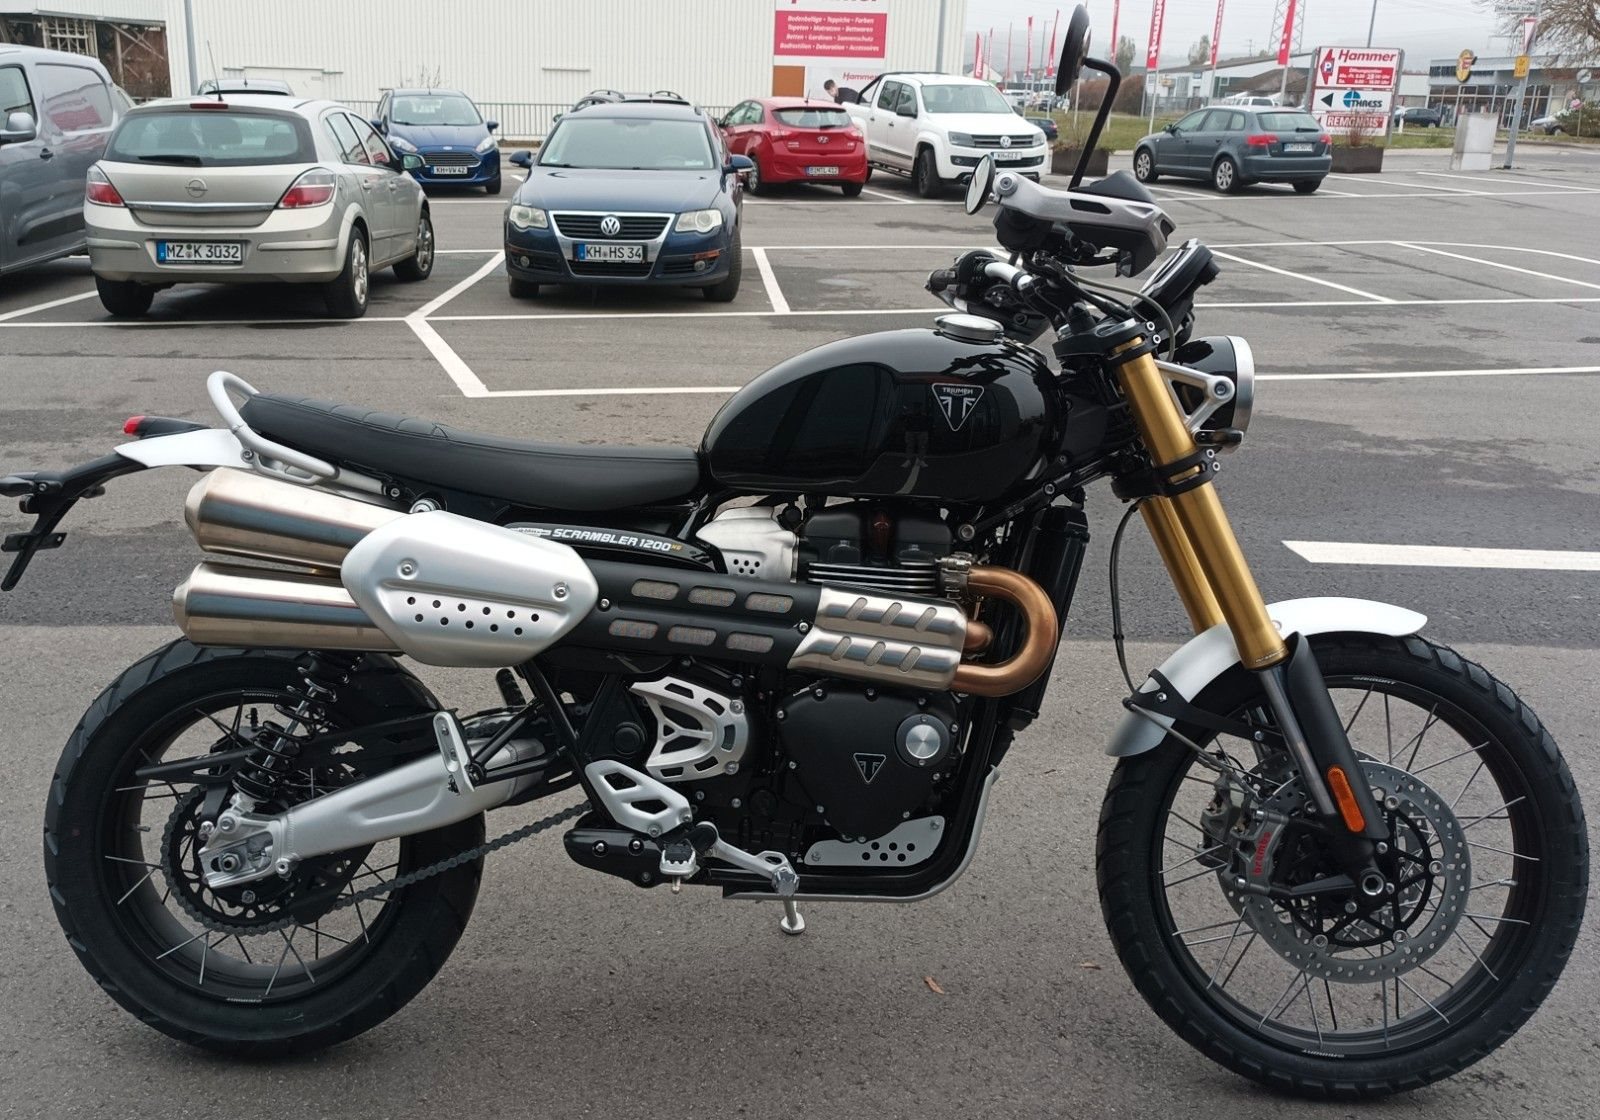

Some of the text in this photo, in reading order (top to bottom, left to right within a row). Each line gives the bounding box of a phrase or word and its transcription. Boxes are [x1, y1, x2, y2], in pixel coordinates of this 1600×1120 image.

[1338, 49, 1396, 62] Hammer
[166, 244, 239, 259] MZ K 3032
[586, 246, 642, 260] KH HS 34
[942, 387, 974, 395] TRIUMPH
[552, 528, 637, 546] SCRAMBLER
[639, 538, 671, 551] 1200
[1253, 832, 1271, 875] brembo
